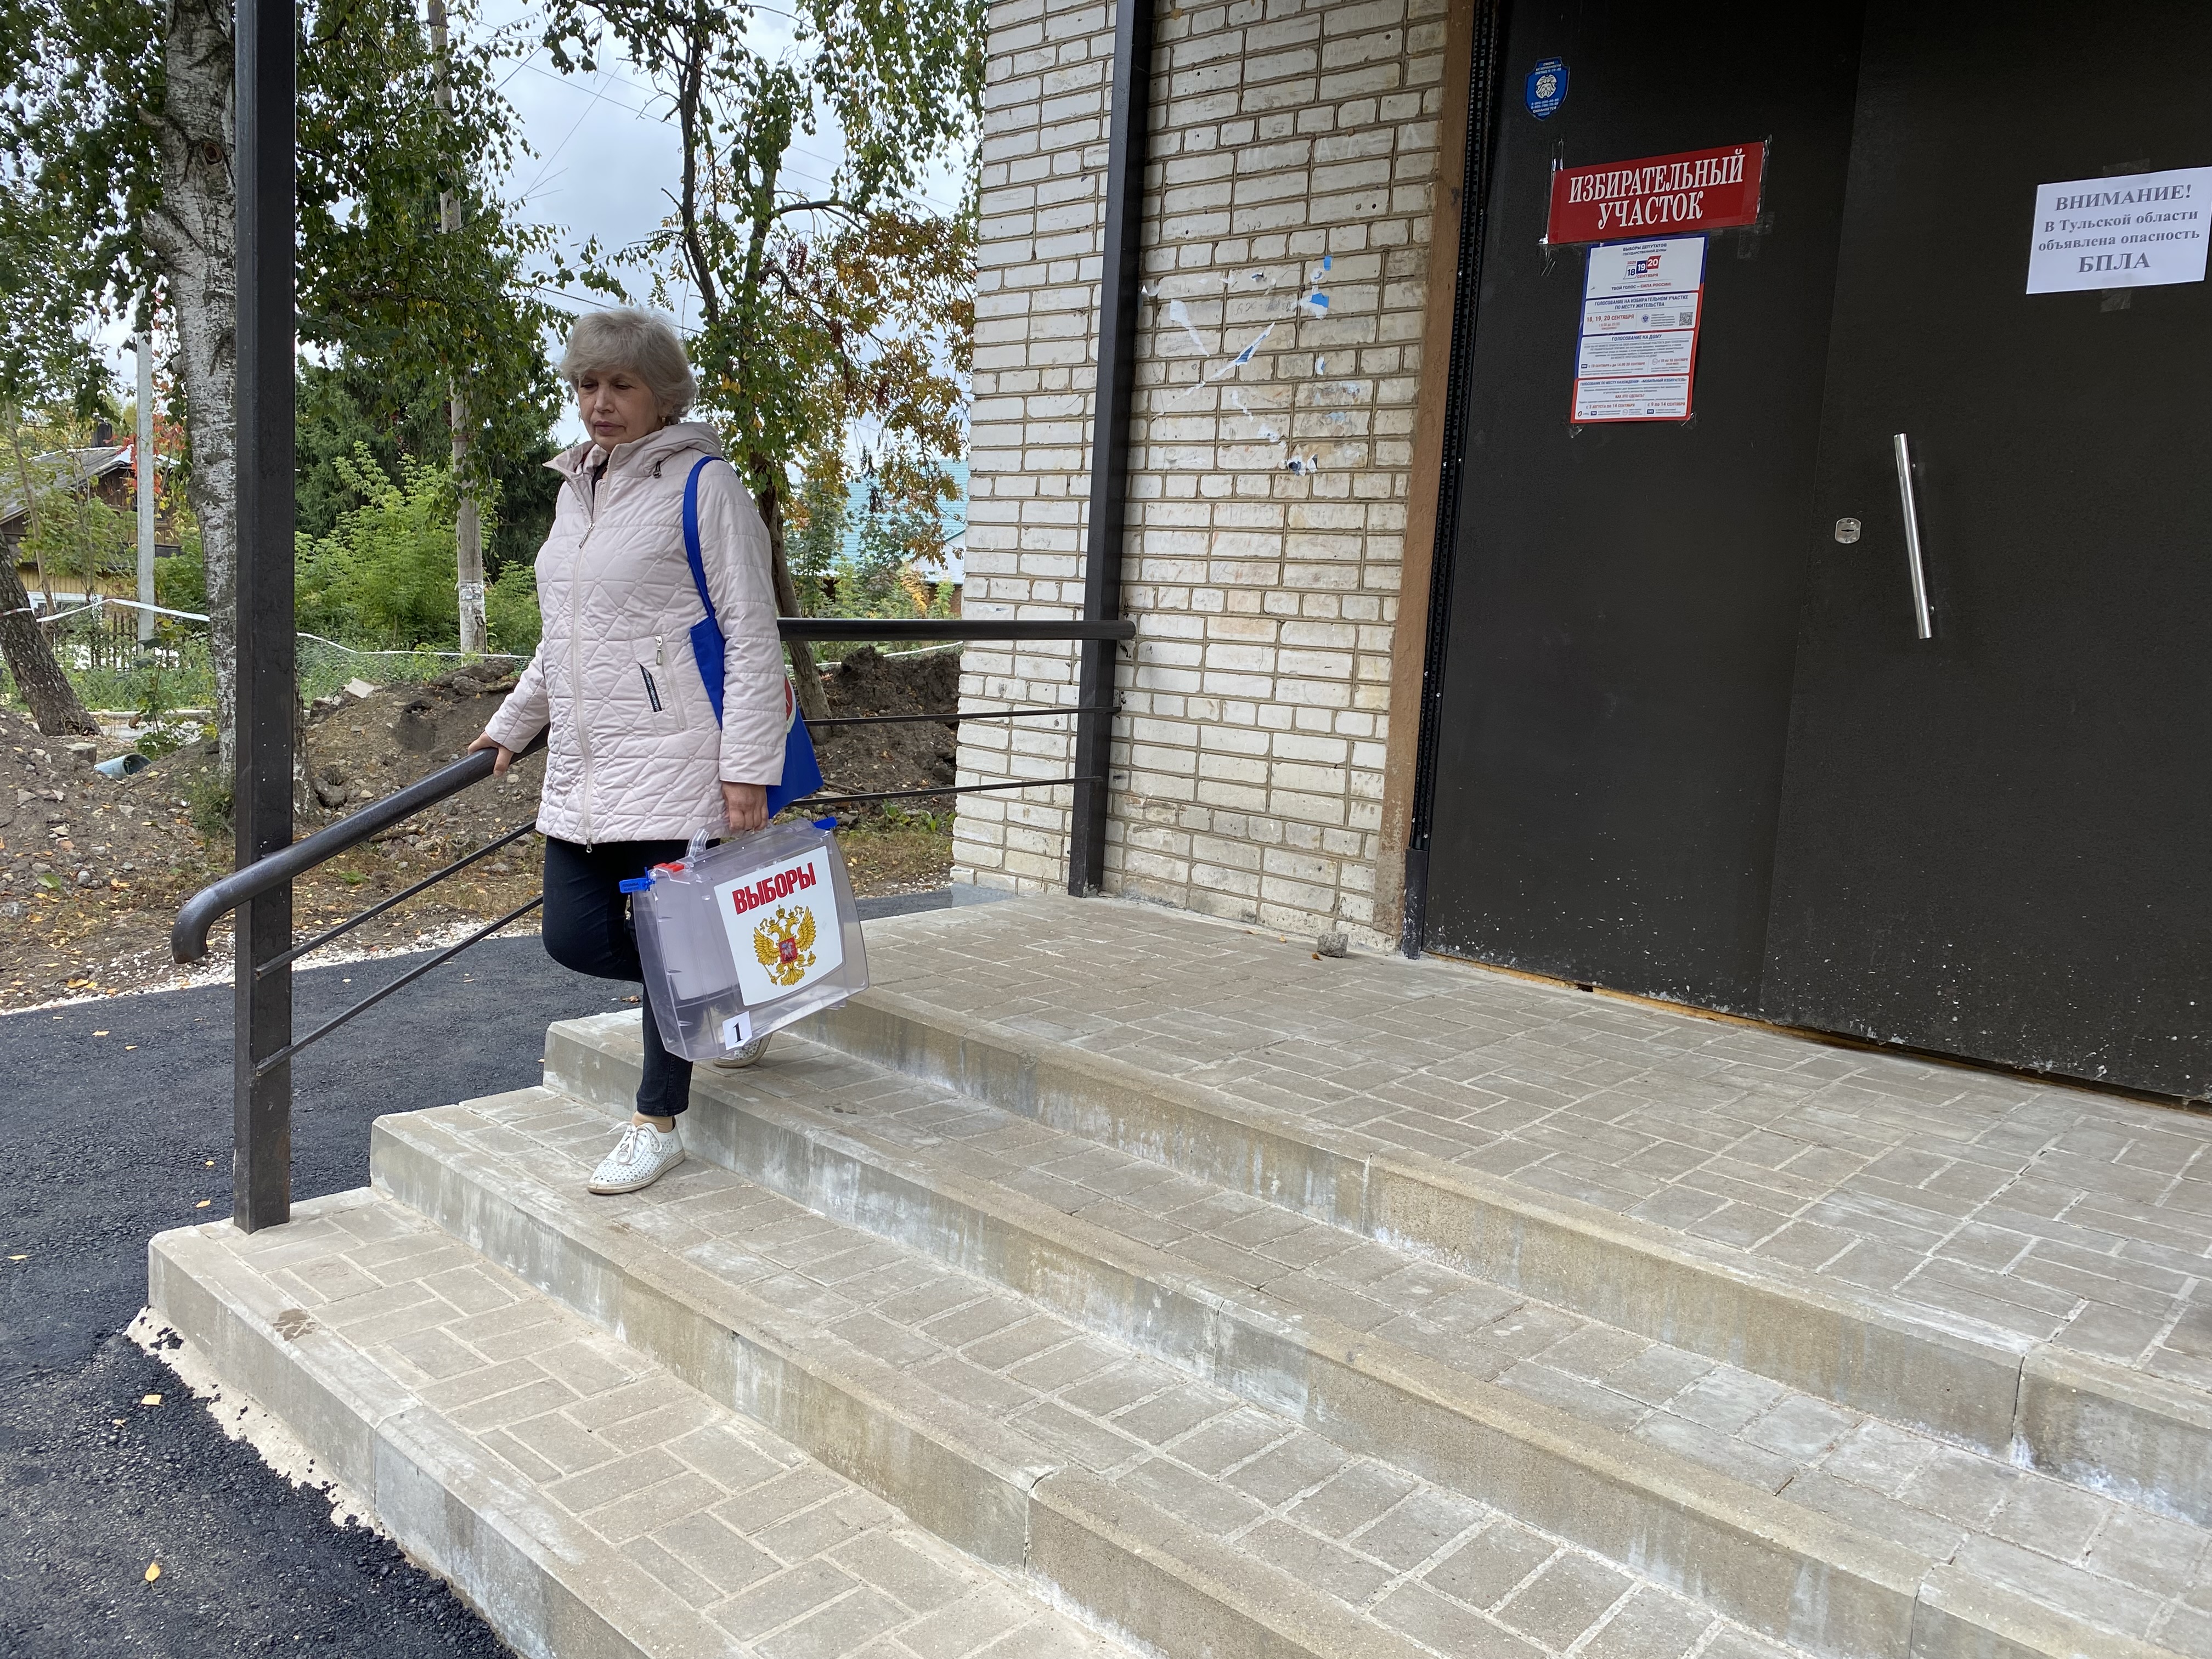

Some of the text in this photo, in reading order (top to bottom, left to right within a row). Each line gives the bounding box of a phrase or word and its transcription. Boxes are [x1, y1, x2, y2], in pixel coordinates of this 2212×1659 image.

[1568, 149, 1746, 203] ИЗБИРАТЕЛЬНЫЙ
[2055, 184, 2192, 211] ВНИМАНИЕ!
[1598, 190, 1705, 230] УЧАСТОК
[2044, 211, 2198, 233] В Тульской области
[2038, 230, 2200, 251] объявлена опасность
[1647, 258, 1658, 267] 20
[2076, 252, 2151, 273] БПЛА
[732, 862, 817, 915] ВЫБОРЫ
[733, 1022, 743, 1043] 1
